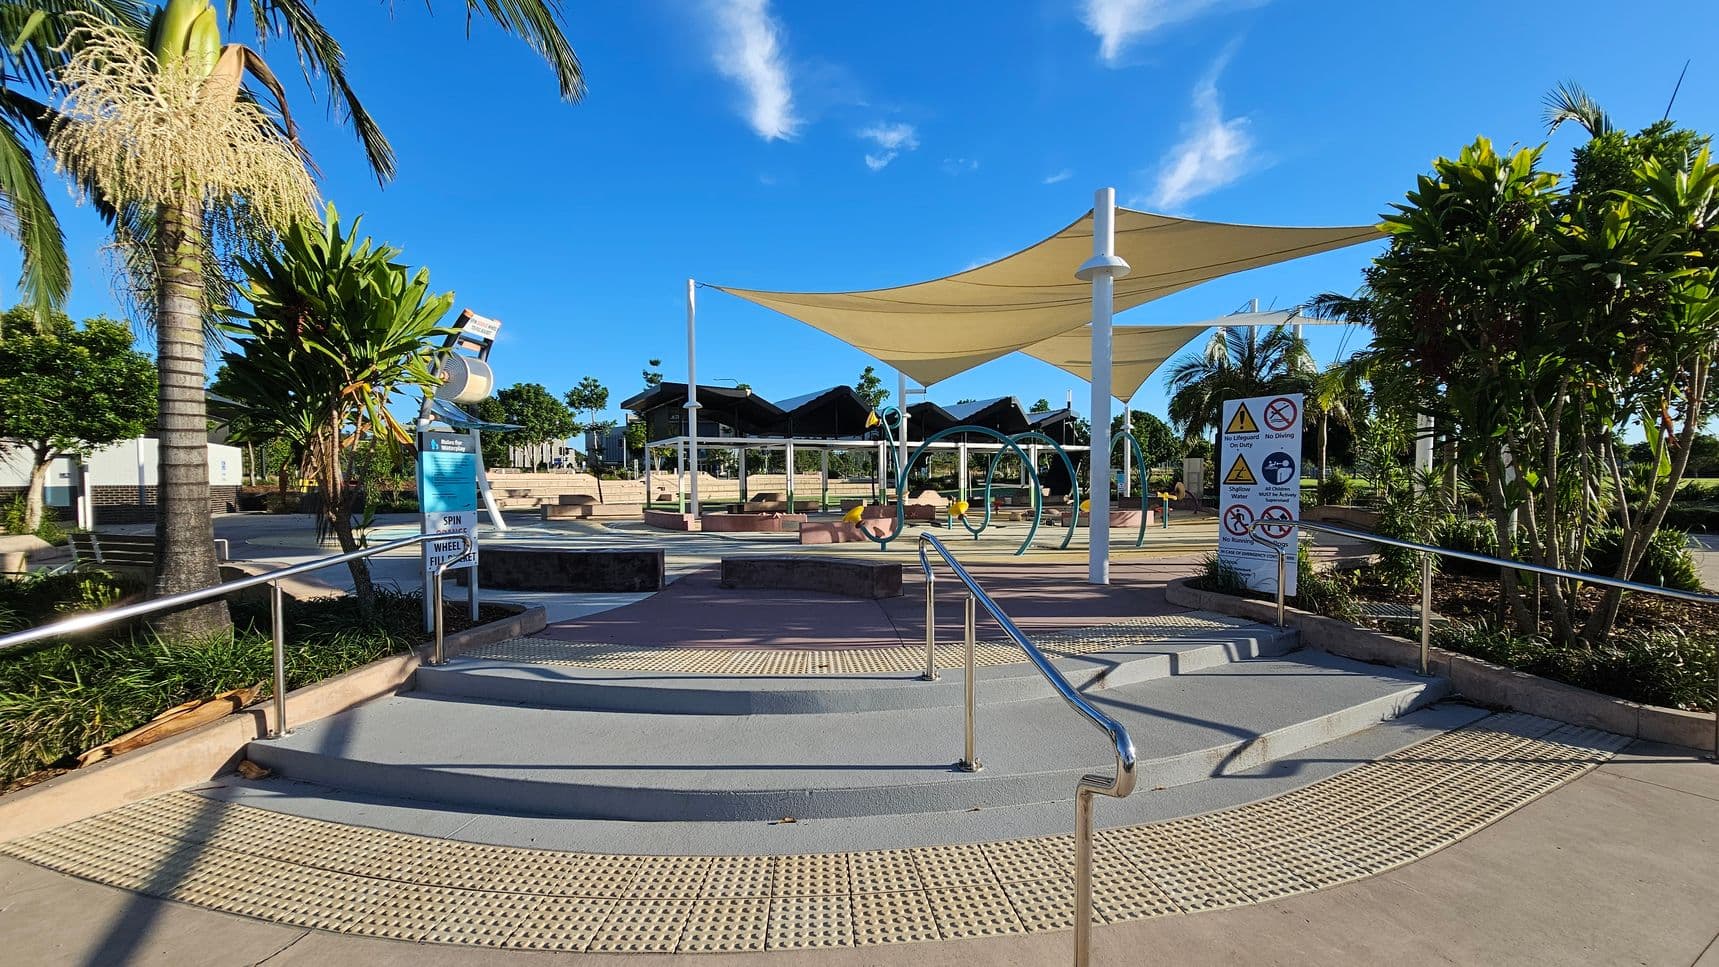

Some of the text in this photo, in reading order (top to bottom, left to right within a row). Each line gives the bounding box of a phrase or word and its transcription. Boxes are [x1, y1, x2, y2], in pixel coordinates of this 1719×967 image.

[444, 516, 462, 525] SPIN
[434, 541, 461, 552] WHEEL
[430, 555, 444, 566] FILL
